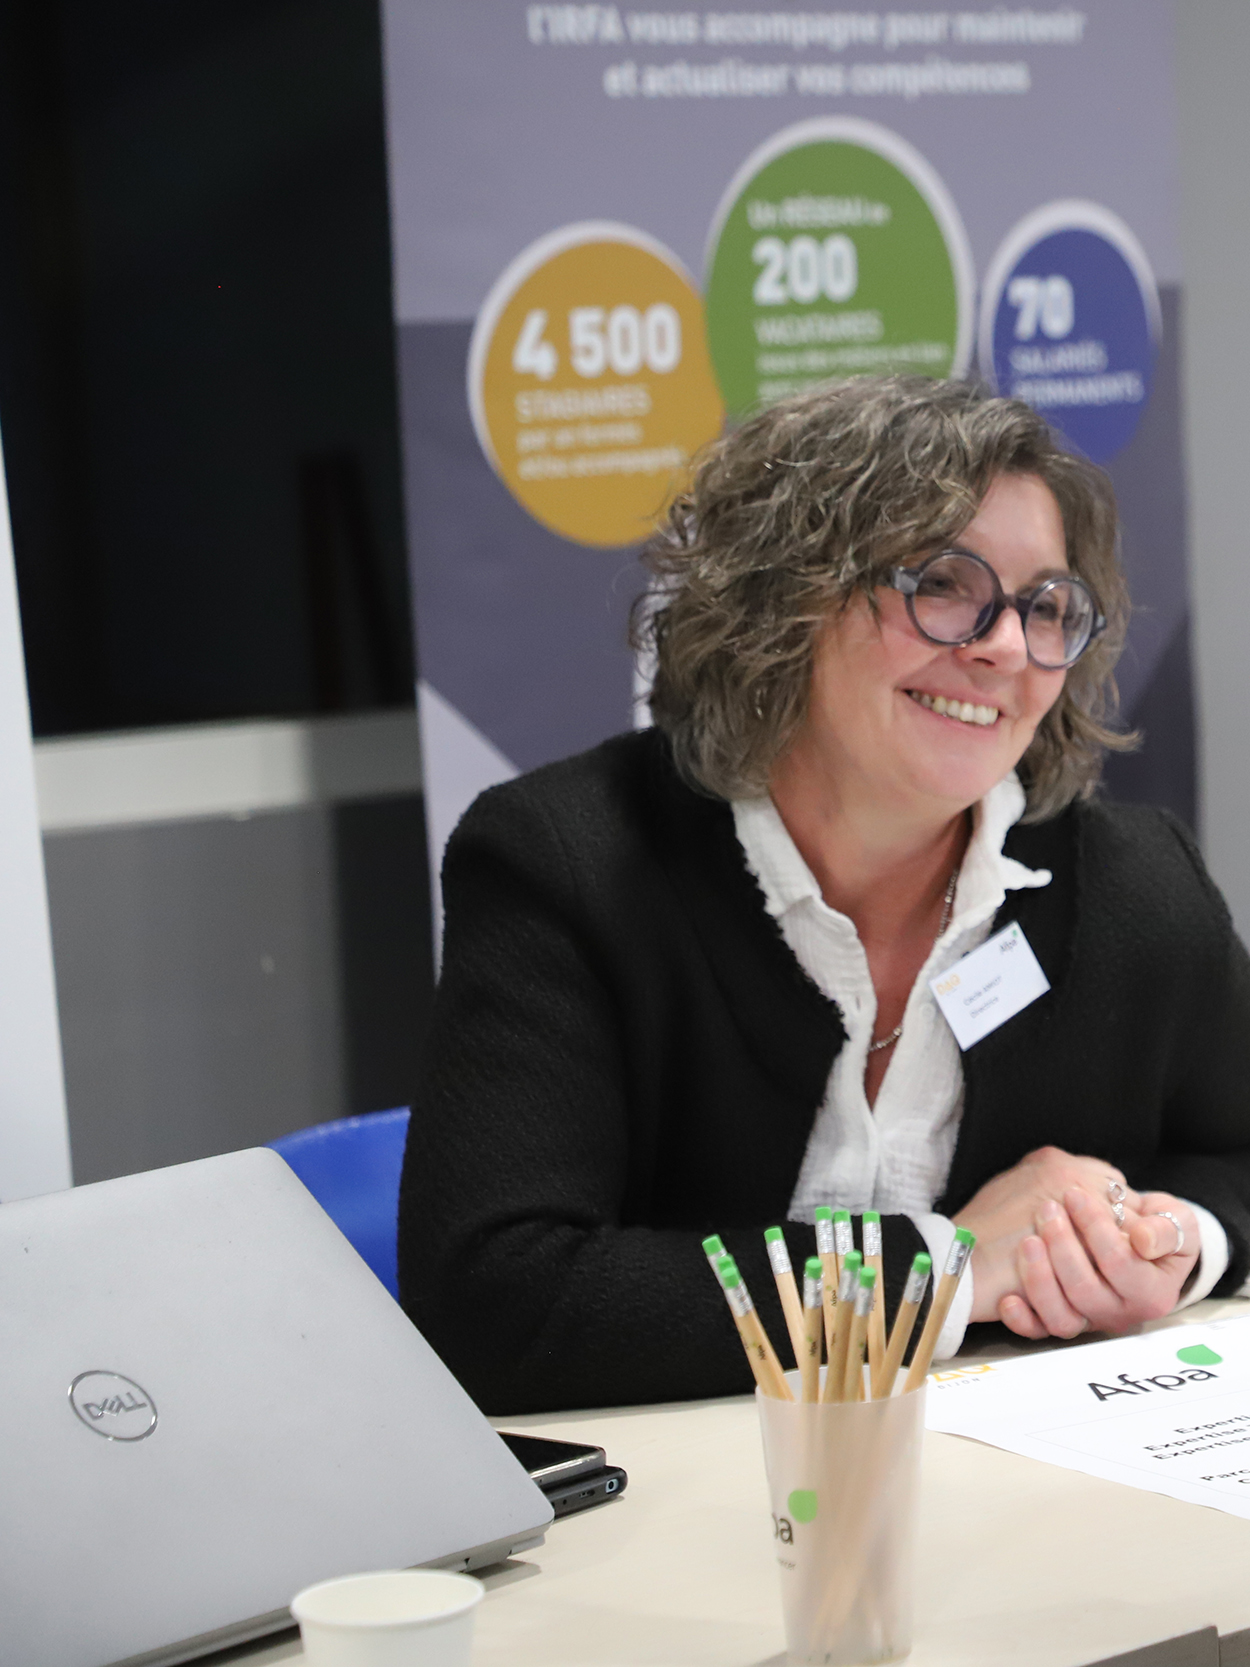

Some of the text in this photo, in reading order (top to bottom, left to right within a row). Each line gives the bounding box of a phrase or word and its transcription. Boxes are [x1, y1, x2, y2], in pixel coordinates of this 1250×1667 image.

[626, 12, 698, 44] vous
[705, 12, 879, 50] accompagne
[883, 12, 948, 51] pour
[952, 5, 1085, 45] maintenir
[604, 55, 1030, 101] et actualiser vos compétences
[752, 233, 858, 305] 200
[1008, 274, 1075, 340] 70
[512, 303, 683, 381] 4 500
[515, 384, 652, 423] STAGIAIRES
[937, 1377, 980, 1390] DIJON
[1088, 1368, 1219, 1402] Afpa
[83, 1392, 148, 1421] DELL
[1143, 1426, 1247, 1452] Expertise
